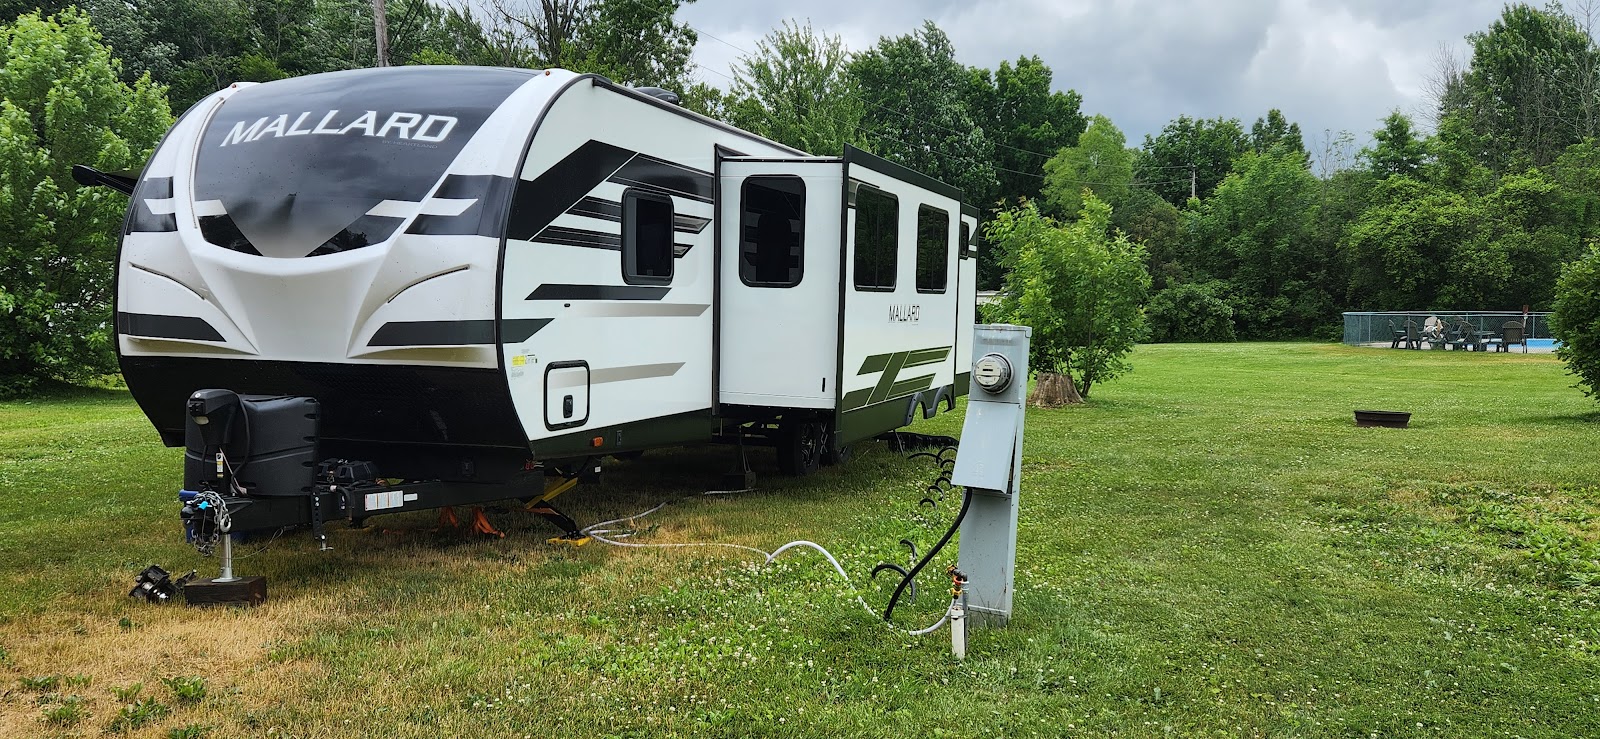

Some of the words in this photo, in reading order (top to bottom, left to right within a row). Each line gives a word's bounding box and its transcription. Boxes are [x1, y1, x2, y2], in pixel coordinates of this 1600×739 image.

[219, 109, 458, 147] MALLARD
[393, 141, 438, 149] HEARTLAND
[888, 305, 920, 321] MALLARD
